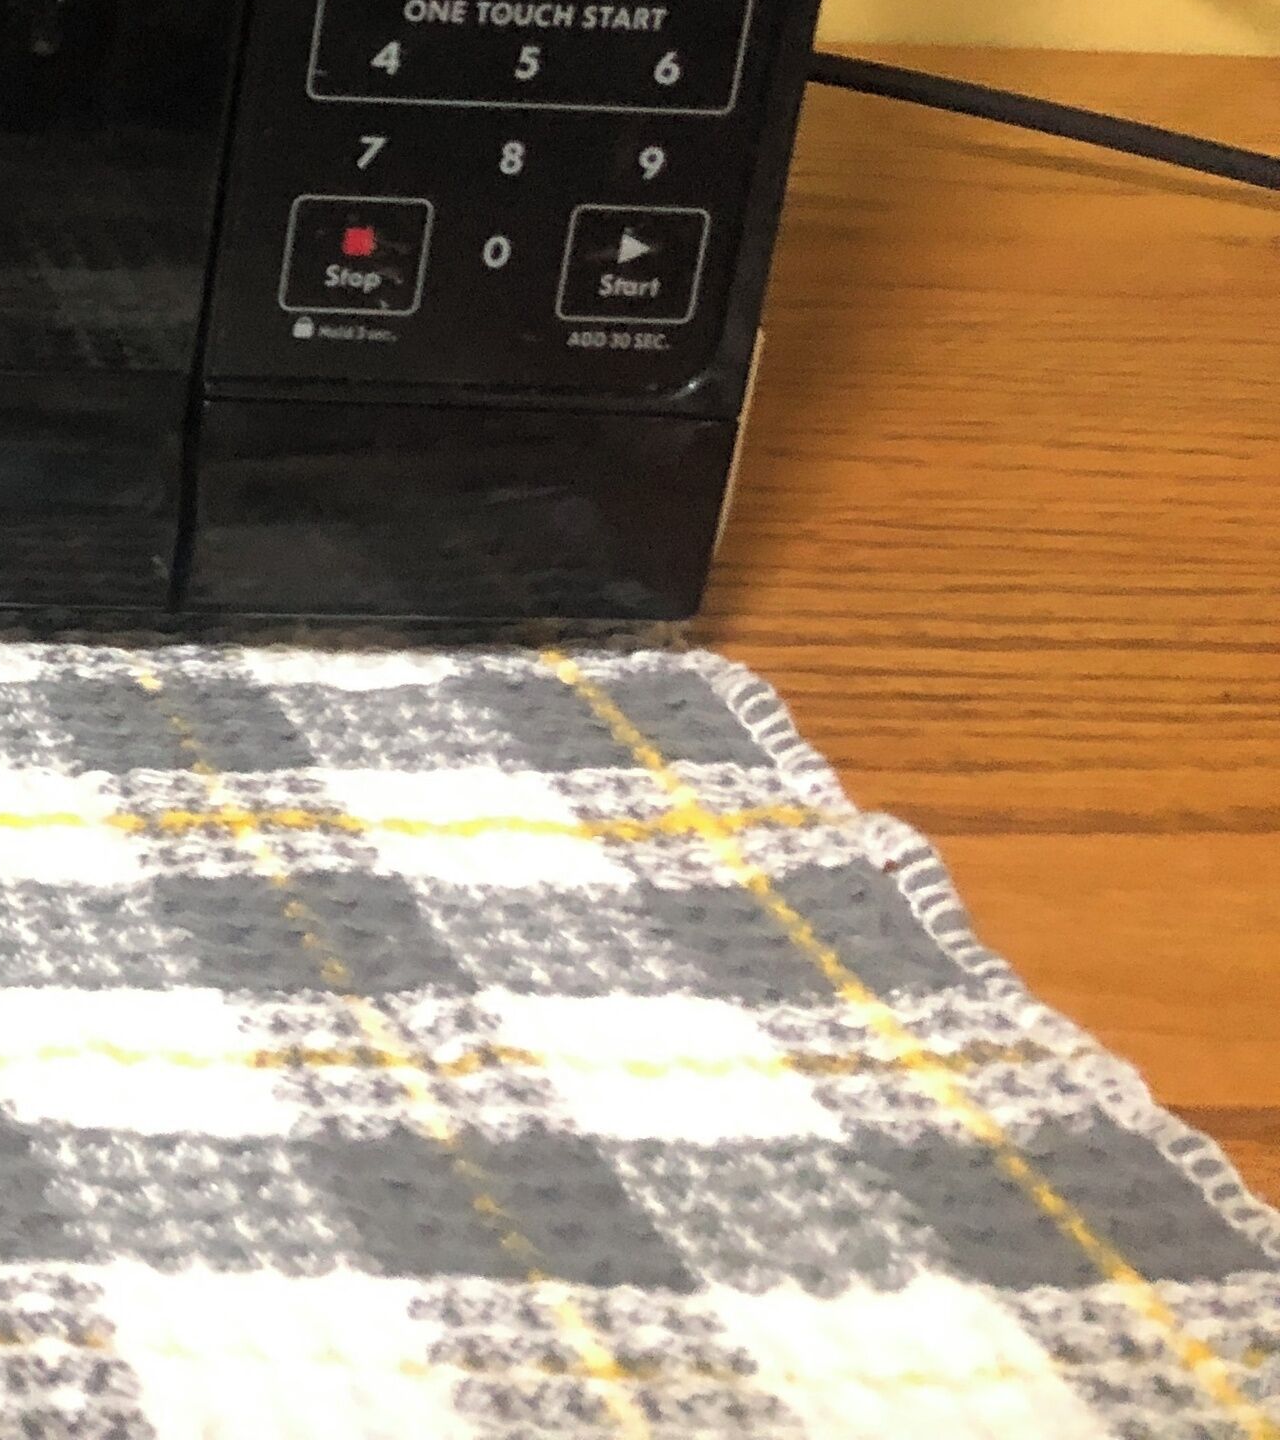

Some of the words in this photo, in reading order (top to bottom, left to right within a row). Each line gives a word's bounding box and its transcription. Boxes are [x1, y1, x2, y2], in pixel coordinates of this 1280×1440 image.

[476, 0, 575, 28] TOUCH
[581, 4, 668, 31] START
[370, 41, 401, 75] 4
[514, 45, 541, 81] 5
[653, 51, 681, 86] 6
[357, 135, 387, 169] 7
[499, 140, 526, 175] 8
[638, 145, 666, 180] 9
[482, 235, 512, 269] 0
[324, 263, 382, 294] Stop
[598, 273, 661, 297] Start
